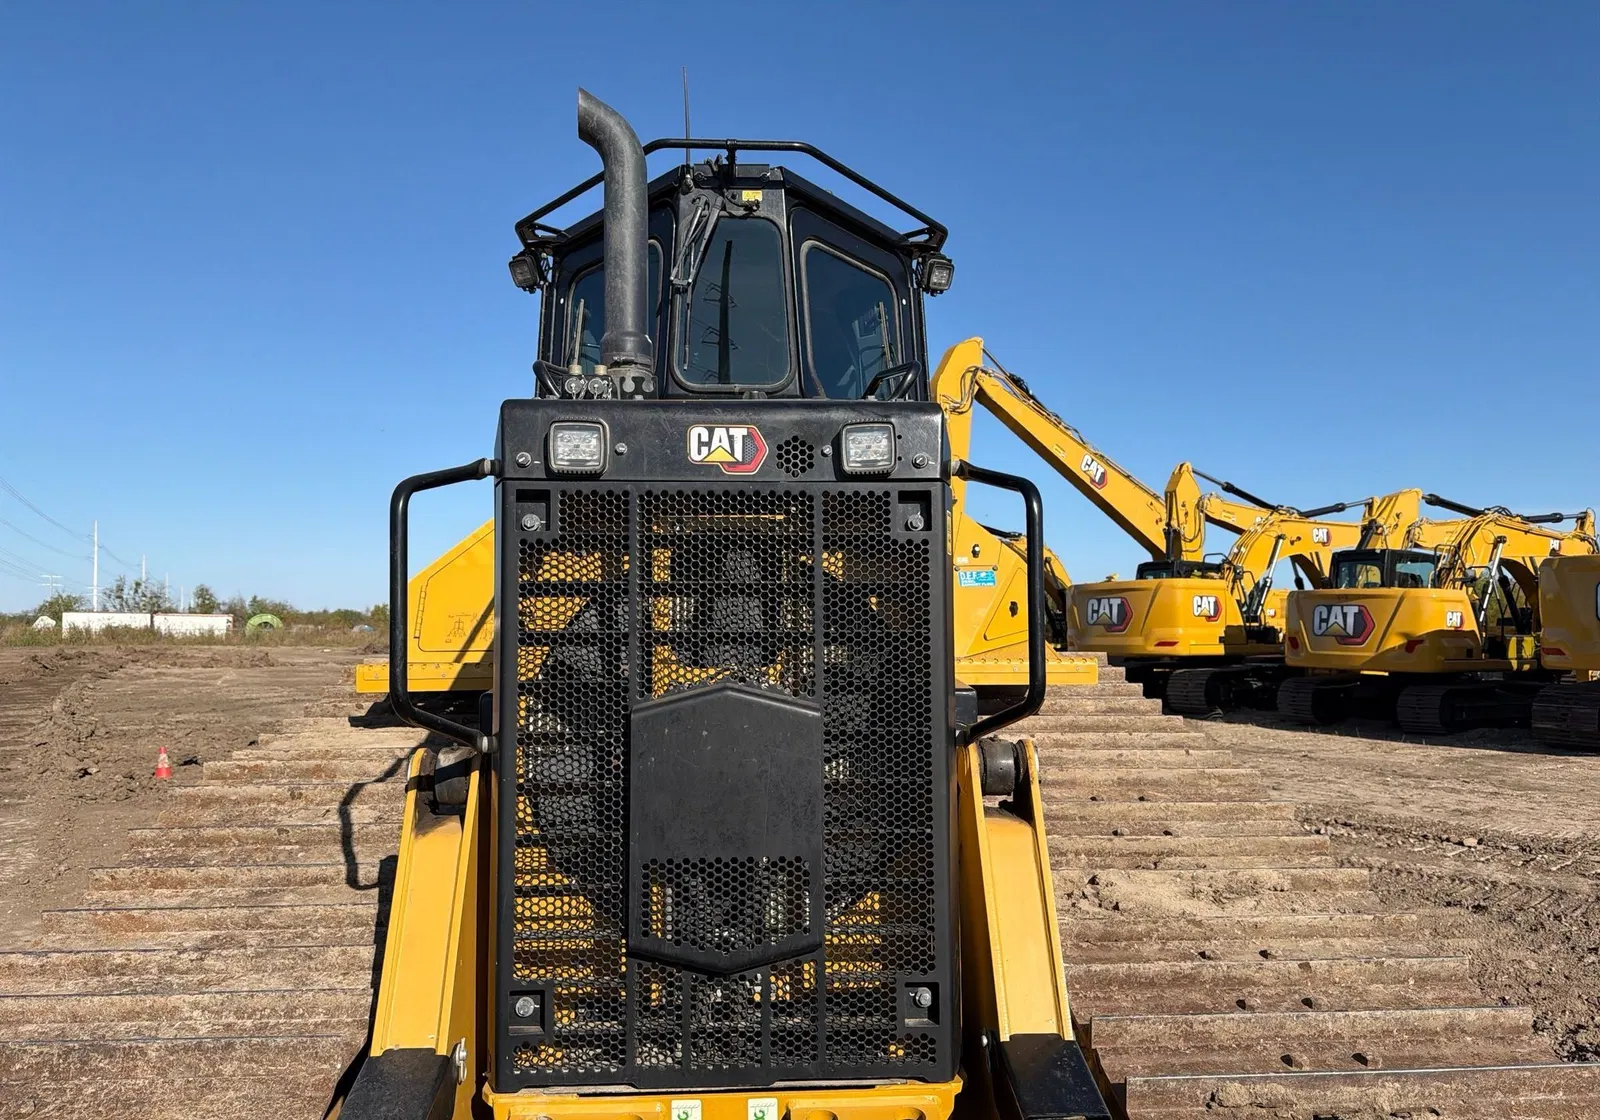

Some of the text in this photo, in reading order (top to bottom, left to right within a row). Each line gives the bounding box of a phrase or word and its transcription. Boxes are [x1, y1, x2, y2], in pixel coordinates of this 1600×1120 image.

[690, 426, 748, 462] CAT
[1081, 454, 1105, 483] CAT
[1313, 528, 1328, 543] CAT
[1087, 597, 1122, 626] CAT
[1193, 595, 1216, 617] CAT
[1314, 605, 1359, 636] CAT
[1446, 611, 1462, 628] CAT
